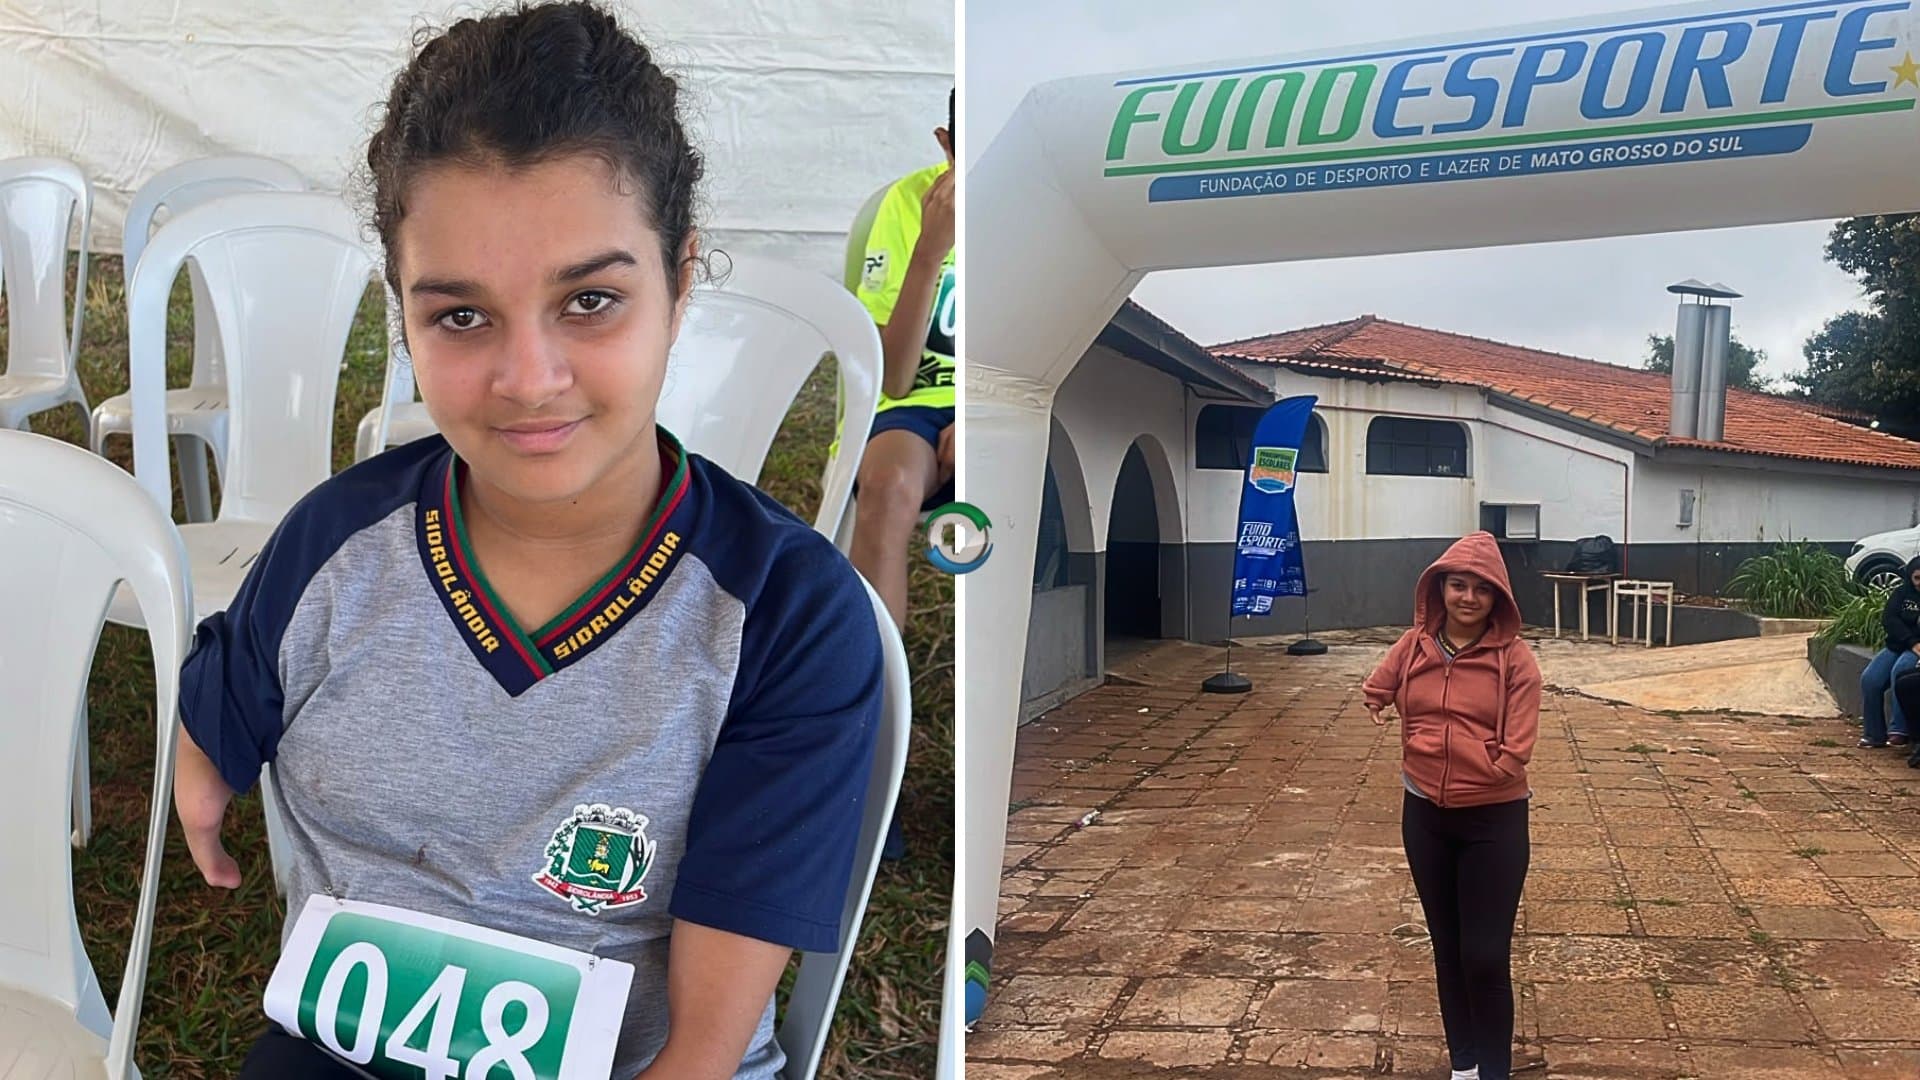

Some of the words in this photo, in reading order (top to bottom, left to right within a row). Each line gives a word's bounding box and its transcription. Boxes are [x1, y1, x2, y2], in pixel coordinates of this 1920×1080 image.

[1106, 3, 1910, 161] FUNDESPORTE
[1200, 172, 1287, 193] FUNDAÇÃO
[1295, 171, 1316, 186] DE
[1325, 164, 1412, 184] DESPORTO
[1420, 162, 1430, 177] E
[1438, 157, 1490, 176] LAZER
[1499, 155, 1522, 171] DE
[1531, 149, 1584, 168] MATO
[1589, 142, 1669, 163] GROSSO
[1672, 139, 1702, 155] DO
[1708, 136, 1743, 153] SUL
[426, 509, 500, 653] SIDROLÂNDIA
[1239, 535, 1287, 549] ESPORTE
[1242, 523, 1272, 536] FUND
[553, 531, 681, 660] SIDROLÂNDIA
[315, 941, 549, 1080] 048
